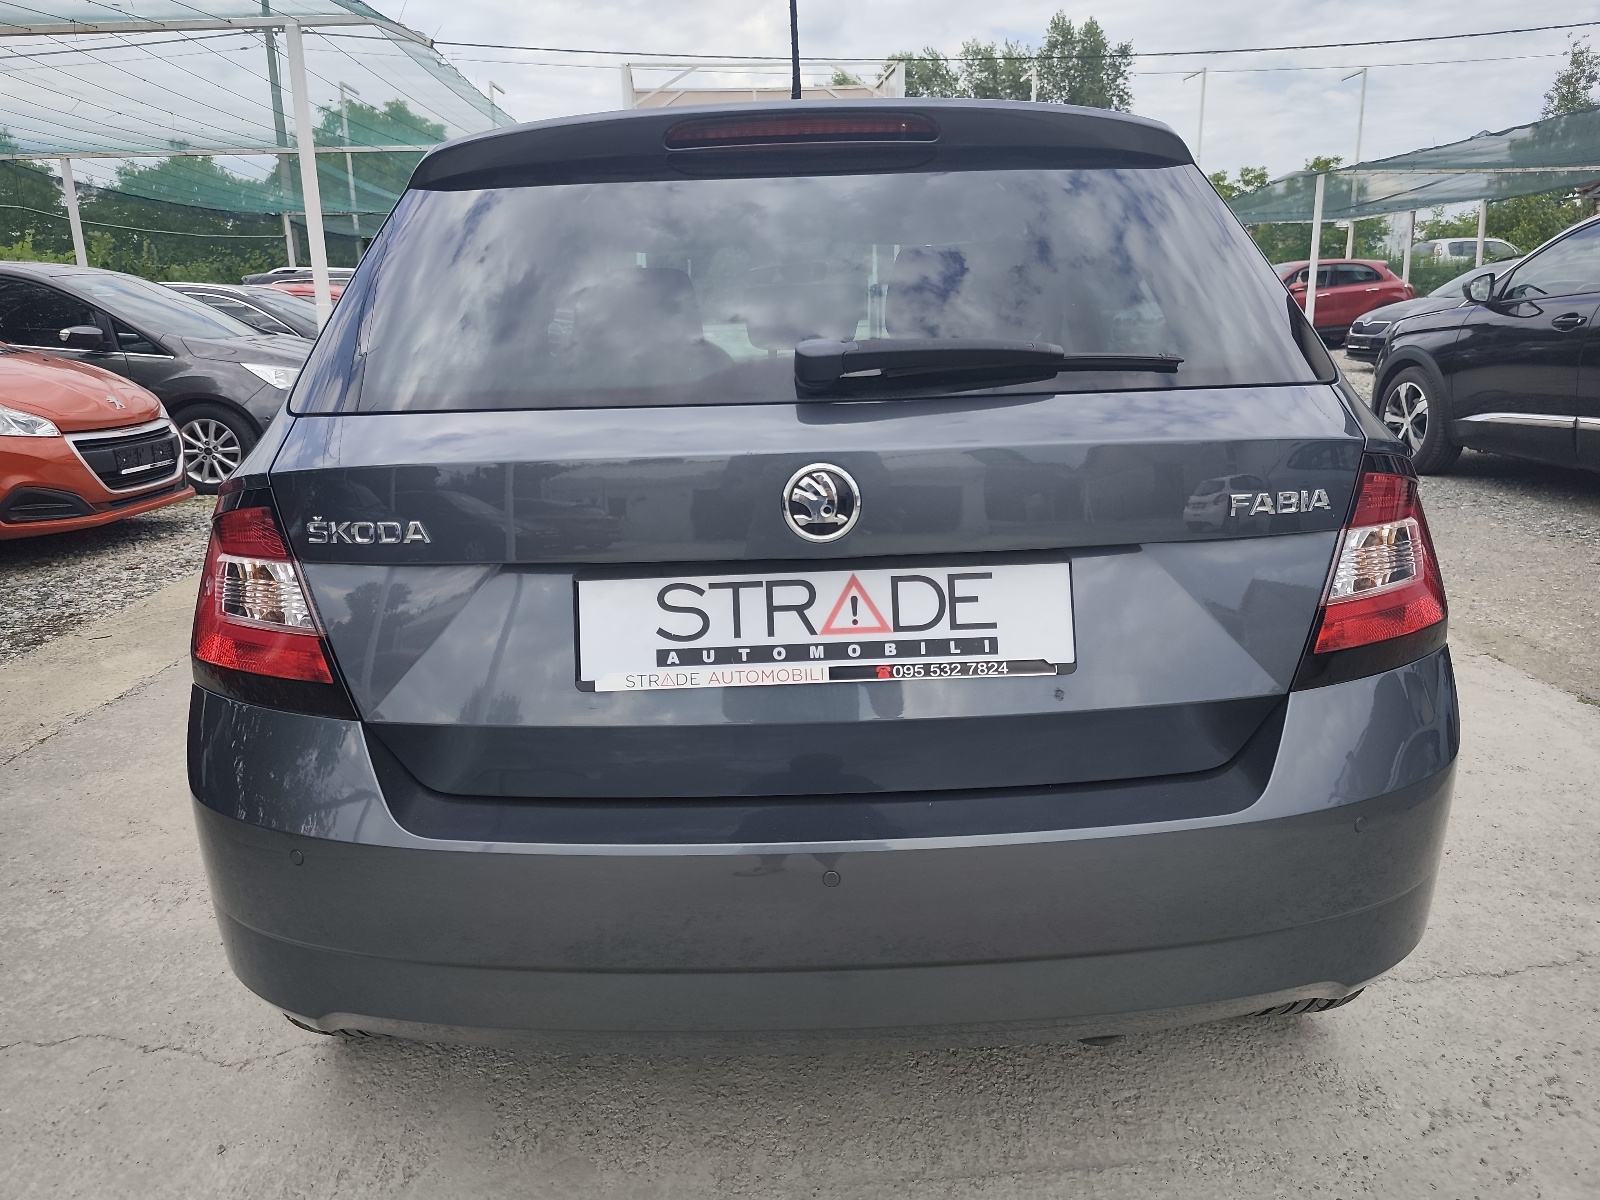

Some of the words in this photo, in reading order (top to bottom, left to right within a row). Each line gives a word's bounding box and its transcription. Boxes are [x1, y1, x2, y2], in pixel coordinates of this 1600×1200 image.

[1230, 489, 1332, 516] FABIA
[307, 516, 431, 544] ŠKODA
[656, 572, 998, 642] STRADE
[667, 639, 991, 666] AUTOMOBILI
[625, 670, 700, 689] STRADE
[708, 667, 825, 685] AUTOMOBILI
[893, 664, 924, 679] 095
[930, 662, 962, 677] 532
[966, 660, 1009, 676] 7824
